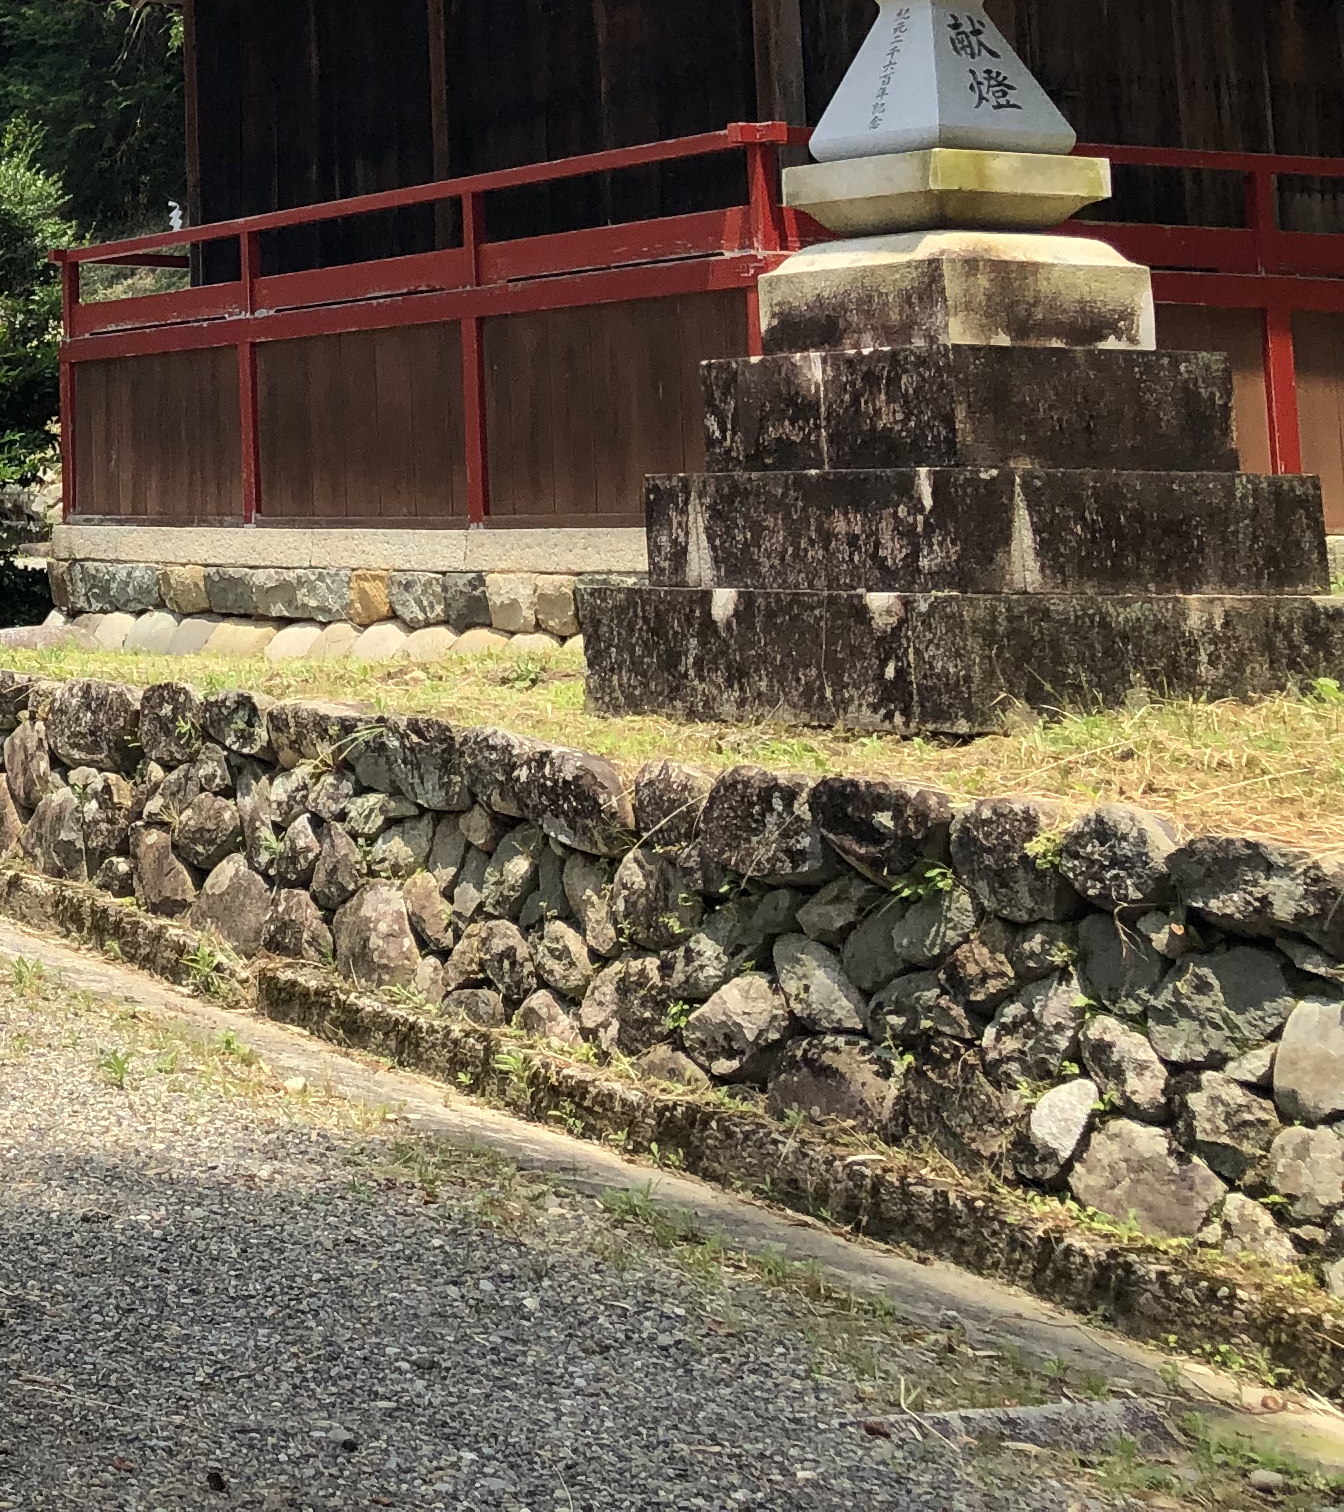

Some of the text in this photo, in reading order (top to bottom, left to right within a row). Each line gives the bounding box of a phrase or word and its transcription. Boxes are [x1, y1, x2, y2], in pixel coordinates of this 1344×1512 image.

[866, 7, 911, 130] 紀元二千六百年記念
[947, 13, 1023, 110] 献燈
